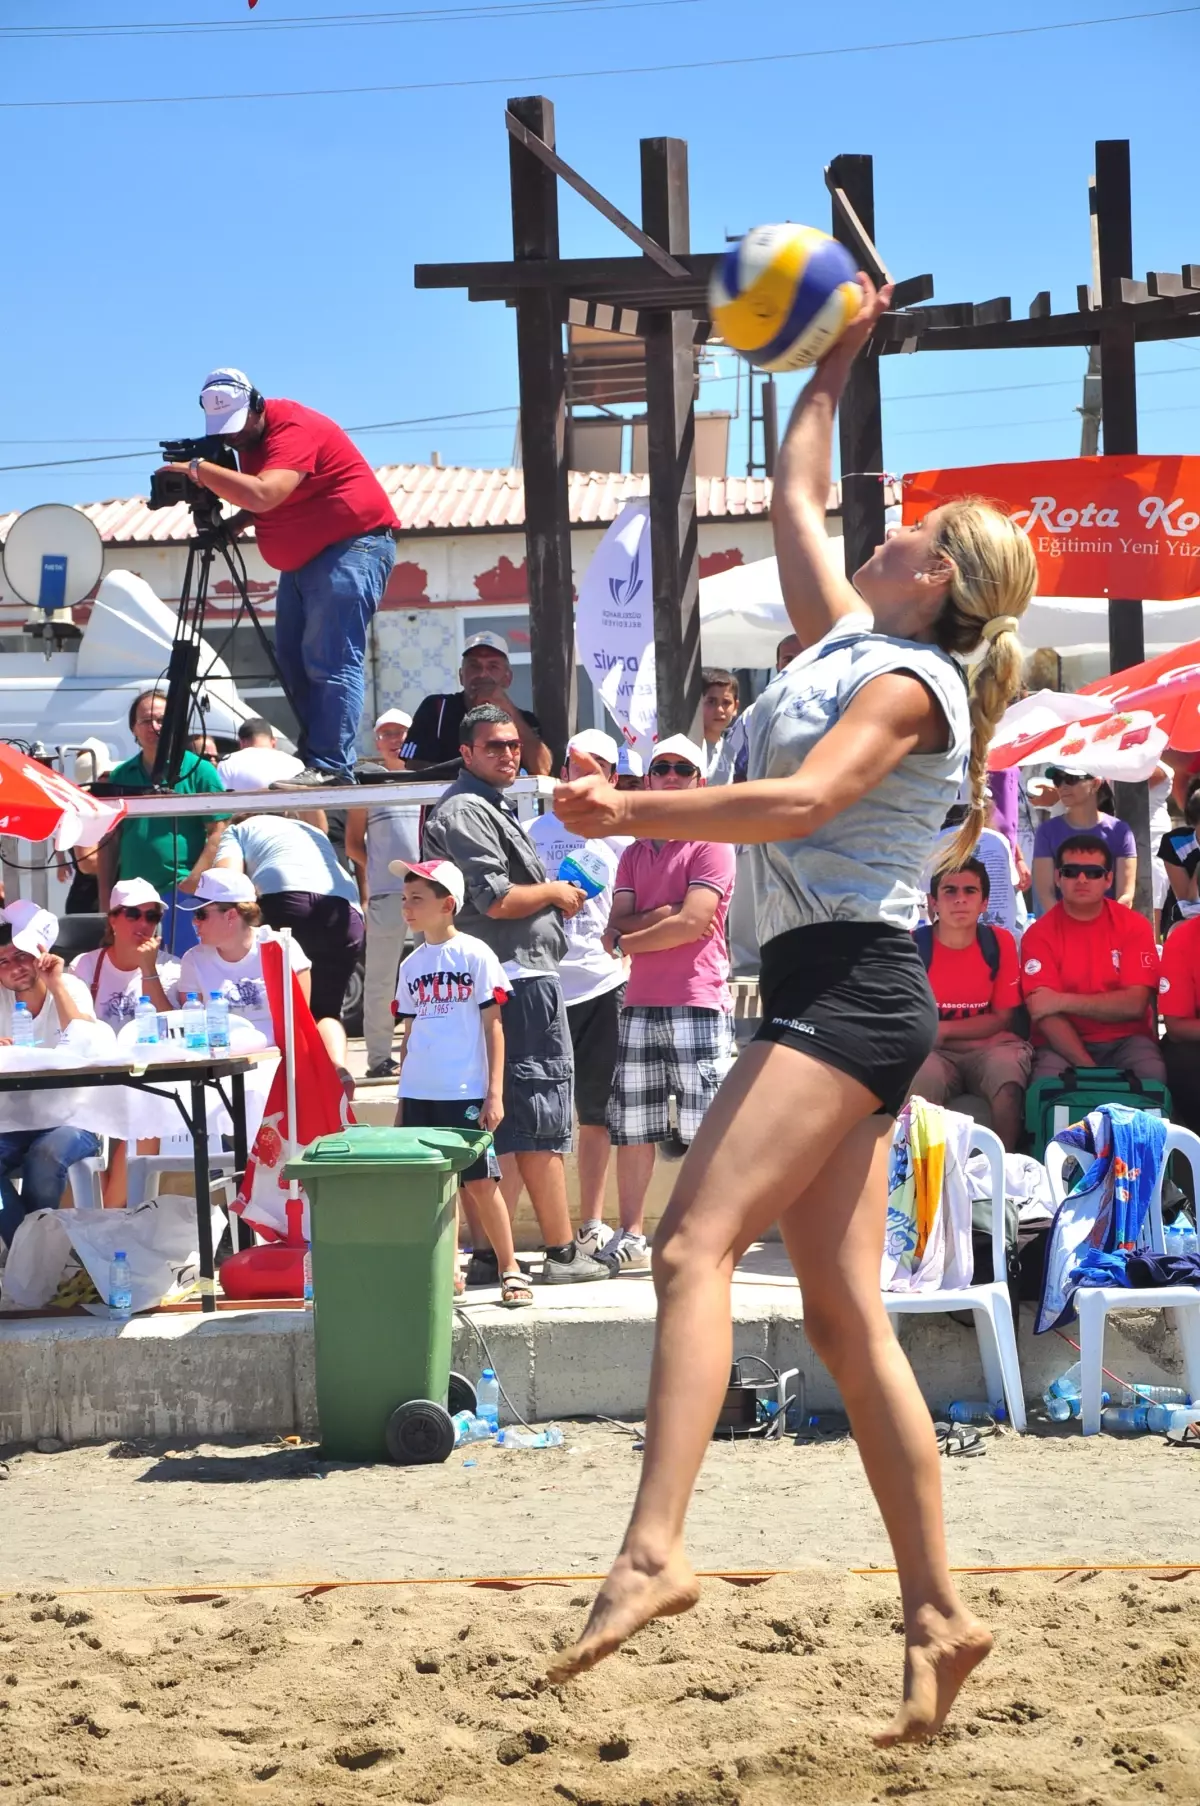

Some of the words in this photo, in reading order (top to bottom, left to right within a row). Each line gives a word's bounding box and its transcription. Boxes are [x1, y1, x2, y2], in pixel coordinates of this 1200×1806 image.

[1008, 496, 1120, 533] Rota
[1037, 537, 1113, 558] Eğitimin
[1119, 538, 1160, 555] Yeni
[771, 1017, 816, 1035] molten
